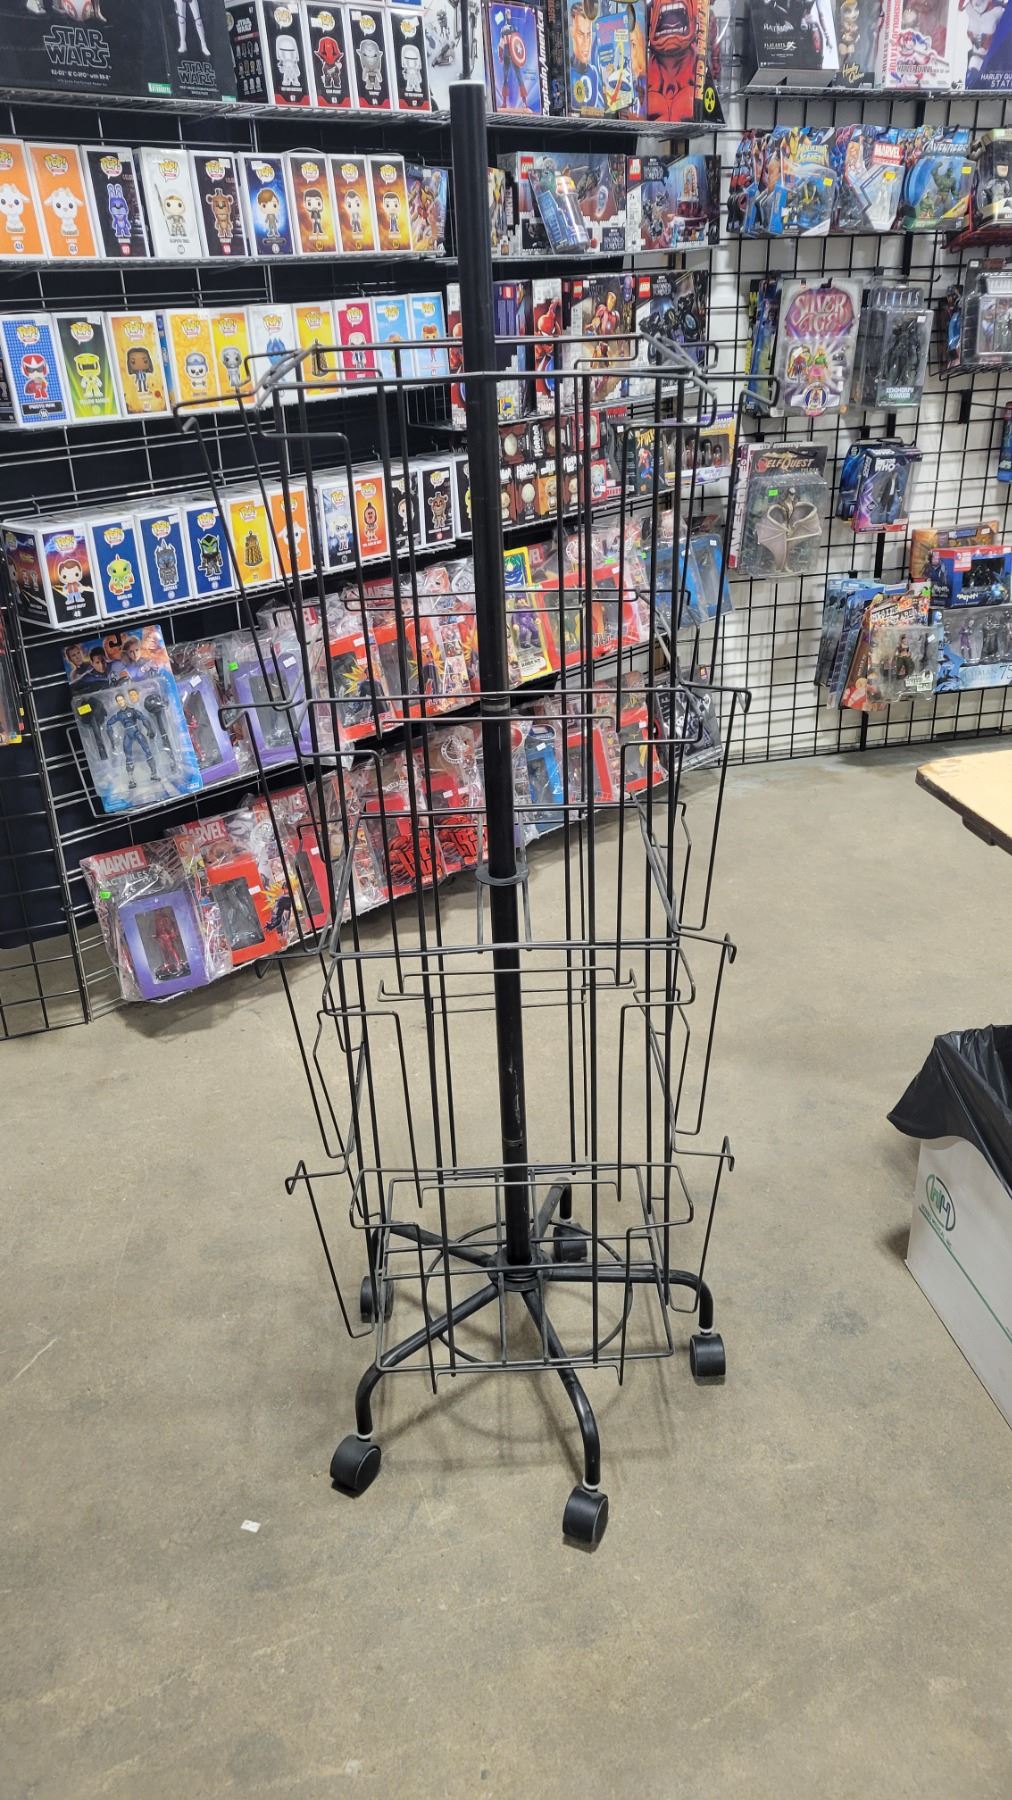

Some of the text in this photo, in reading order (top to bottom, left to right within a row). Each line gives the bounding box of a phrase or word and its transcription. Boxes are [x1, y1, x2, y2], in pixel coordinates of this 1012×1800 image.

[43, 25, 109, 50] STAR
[45, 43, 111, 69] WARS
[177, 60, 214, 74] STAR
[178, 70, 216, 87] WARS
[694, 60, 705, 100] RED
[980, 73, 1002, 81] HARLEY
[990, 79, 1012, 88] STAT
[874, 142, 900, 157] MARVEL
[922, 140, 969, 152] AVENGERS
[876, 291, 920, 305] ALIENS
[767, 458, 815, 471] ELFQUEST
[875, 463, 896, 472] WHO
[97, 850, 145, 876] MARVEL
